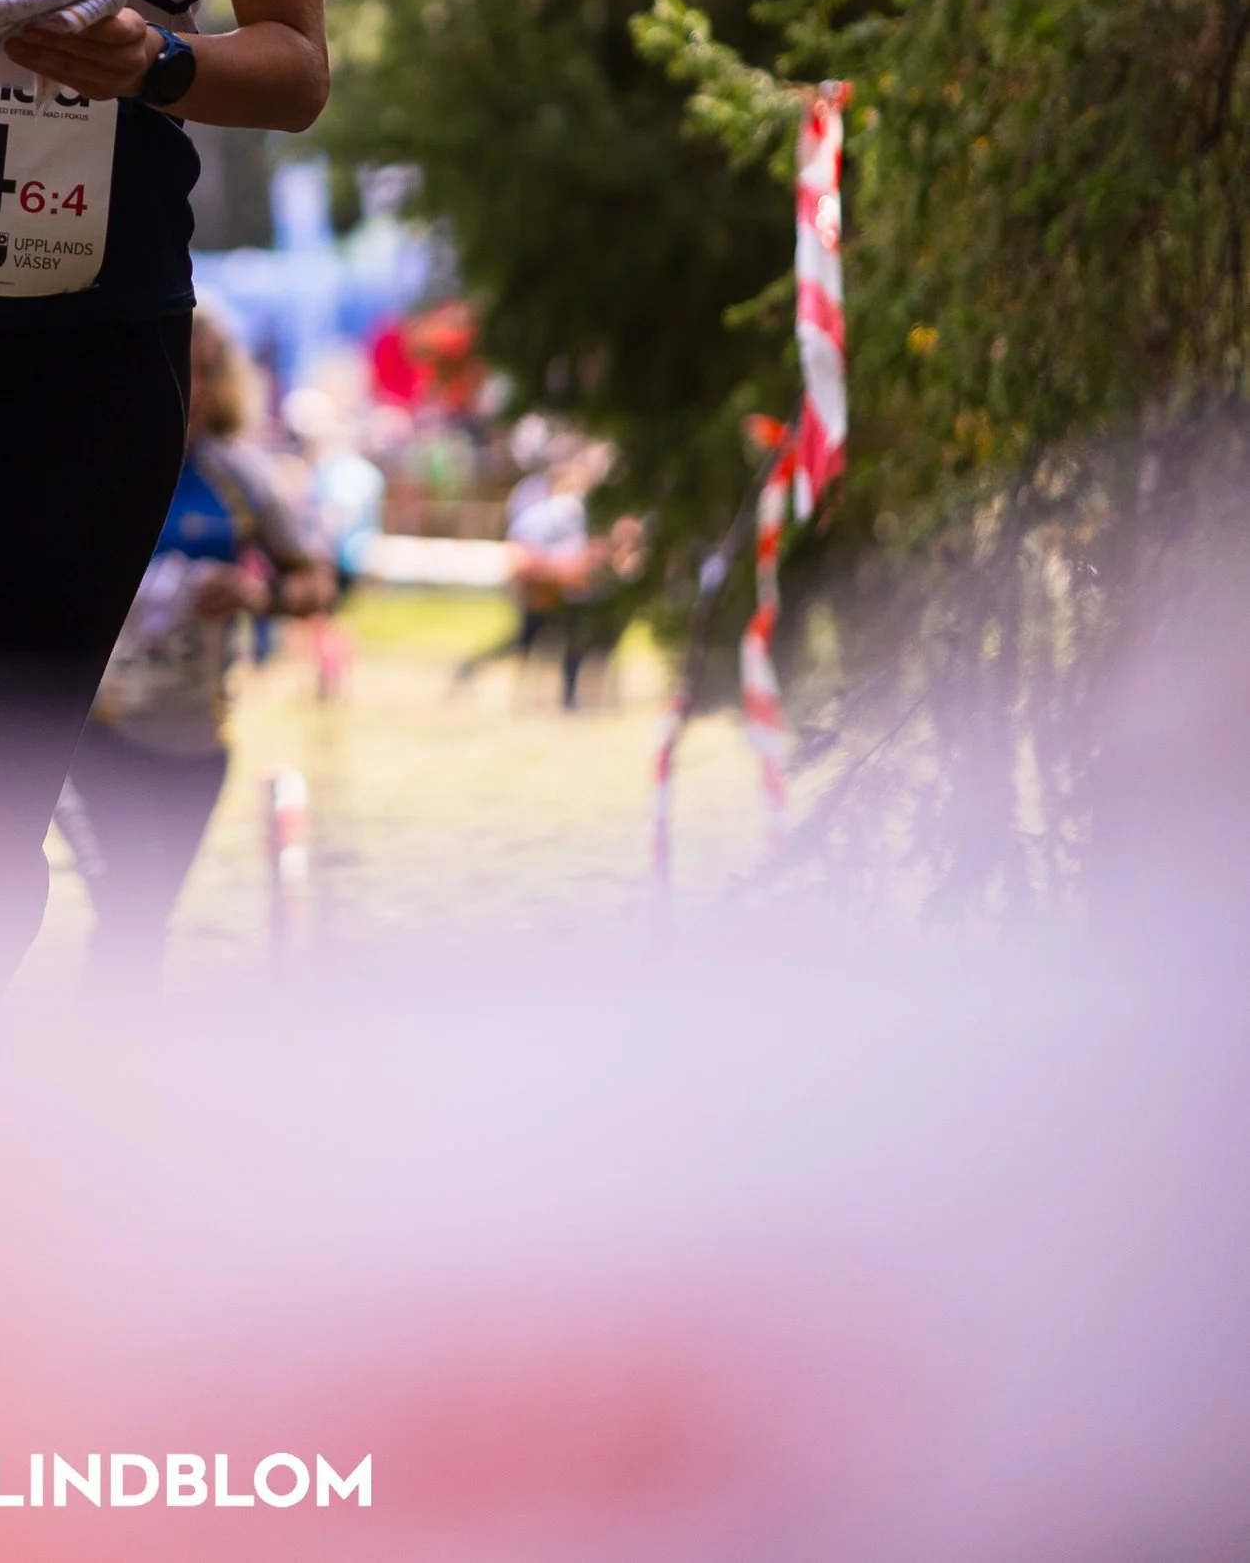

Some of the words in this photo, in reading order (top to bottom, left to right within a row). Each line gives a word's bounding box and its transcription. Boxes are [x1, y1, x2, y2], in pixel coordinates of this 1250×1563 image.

[65, 112, 89, 121] FOKUS
[20, 181, 88, 217] 6:4
[14, 237, 94, 256] UPPLANDS
[14, 253, 62, 271] VÄSBY
